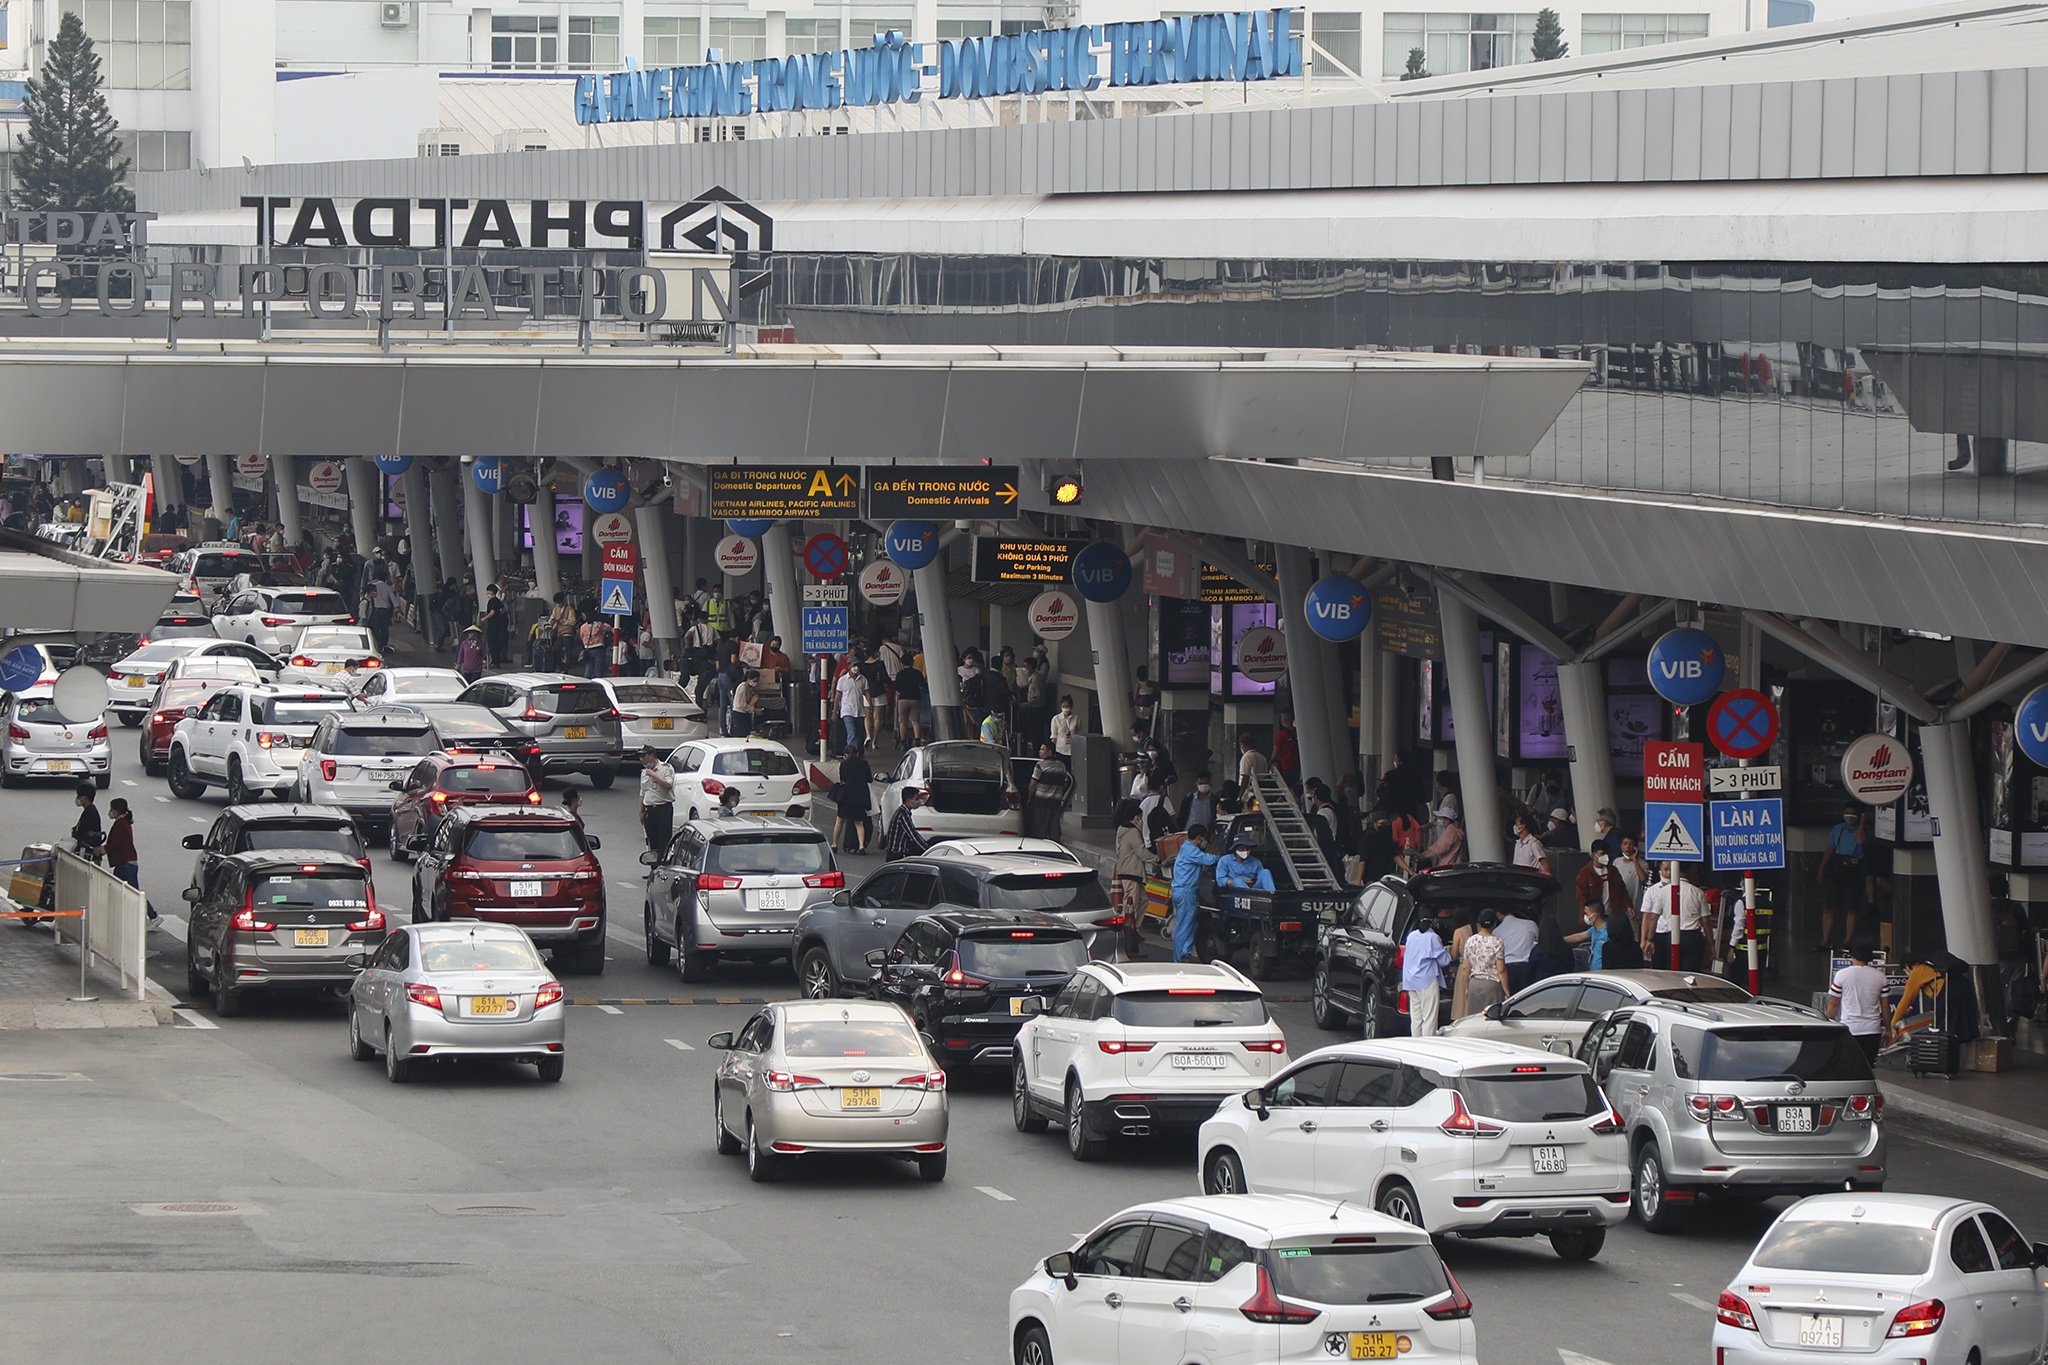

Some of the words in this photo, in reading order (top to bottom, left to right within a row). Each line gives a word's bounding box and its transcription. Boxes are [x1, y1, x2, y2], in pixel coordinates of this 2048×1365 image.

[671, 48, 752, 118] KHÔNG
[752, 51, 842, 113] TRONG
[938, 24, 1104, 100] DOMESTIC
[1103, 8, 1302, 87] TERMINAL
[26, 261, 740, 323] CORPORATION
[714, 472, 729, 480] GA
[731, 472, 741, 480] ĐI
[743, 472, 777, 480] TRONG
[779, 470, 807, 480] NƯỚC
[714, 482, 753, 490] Domestic
[755, 482, 802, 492] Departures
[807, 469, 833, 496] A
[874, 482, 890, 491] GA
[892, 478, 915, 491] ĐẾN
[918, 482, 956, 491] TRONG
[958, 479, 990, 491] NƯỚC
[592, 486, 616, 499] VIB
[748, 500, 788, 509] AIRLINES,
[789, 500, 818, 508] PACIFIC
[820, 500, 856, 508] AIRLINES
[907, 496, 950, 505] Domestic
[953, 496, 990, 505] Arrivals
[894, 538, 923, 552] VIB
[1000, 543, 1016, 551] KHU
[1018, 544, 1033, 553] VỰC
[610, 546, 628, 559] CẤM
[720, 554, 754, 562] Dongtam
[997, 553, 1024, 561] KHÔNG
[1049, 553, 1069, 562] PHÚT
[616, 562, 634, 573] KHÁCH
[1026, 564, 1051, 573] Parking
[1000, 572, 1032, 580] Maximum
[1038, 573, 1064, 581] Minutes
[1081, 567, 1114, 583] VIB
[864, 582, 902, 590] Dongtam
[815, 590, 821, 598] 3
[823, 587, 846, 599] PHÚT
[1315, 602, 1351, 620] VIB
[808, 611, 831, 625] LÀN
[833, 614, 841, 625] A
[1035, 614, 1074, 623] Dongtam
[815, 640, 831, 649] KHÁCH
[1243, 654, 1287, 663] Dongtam
[1660, 660, 1702, 680] VIB
[1657, 748, 1690, 767] CẤM
[1729, 774, 1737, 788] 3
[1741, 769, 1777, 787] PHÚT
[1852, 769, 1907, 781] Dongtam
[1647, 773, 1667, 790] ĐÓN
[1669, 774, 1701, 791] KHÁCH
[1720, 805, 1754, 828] LÀN
[1759, 809, 1772, 826] A
[1714, 833, 1727, 846] NƠI
[1728, 831, 1749, 846] DỪNG
[1749, 830, 1765, 846] CHỜ
[1766, 833, 1782, 847] TẠM
[1717, 849, 1731, 864] TRẢ
[1733, 851, 1756, 864] KHÁCH
[1758, 852, 1768, 863] GA
[1768, 851, 1777, 862] ĐI
[765, 890, 780, 899] 51G
[760, 899, 786, 908] 823.53
[481, 997, 497, 1005] 61A
[475, 1006, 503, 1014] 227.77
[852, 1088, 870, 1097] 51H
[846, 1098, 878, 1106] 297.48
[1785, 1108, 1804, 1120] 63A
[1539, 1148, 1558, 1160] 61A
[1811, 1318, 1832, 1332] 71A
[1362, 1334, 1383, 1346] 51H
[1801, 1332, 1840, 1345] 097.15
[1356, 1346, 1392, 1358] 705.27
